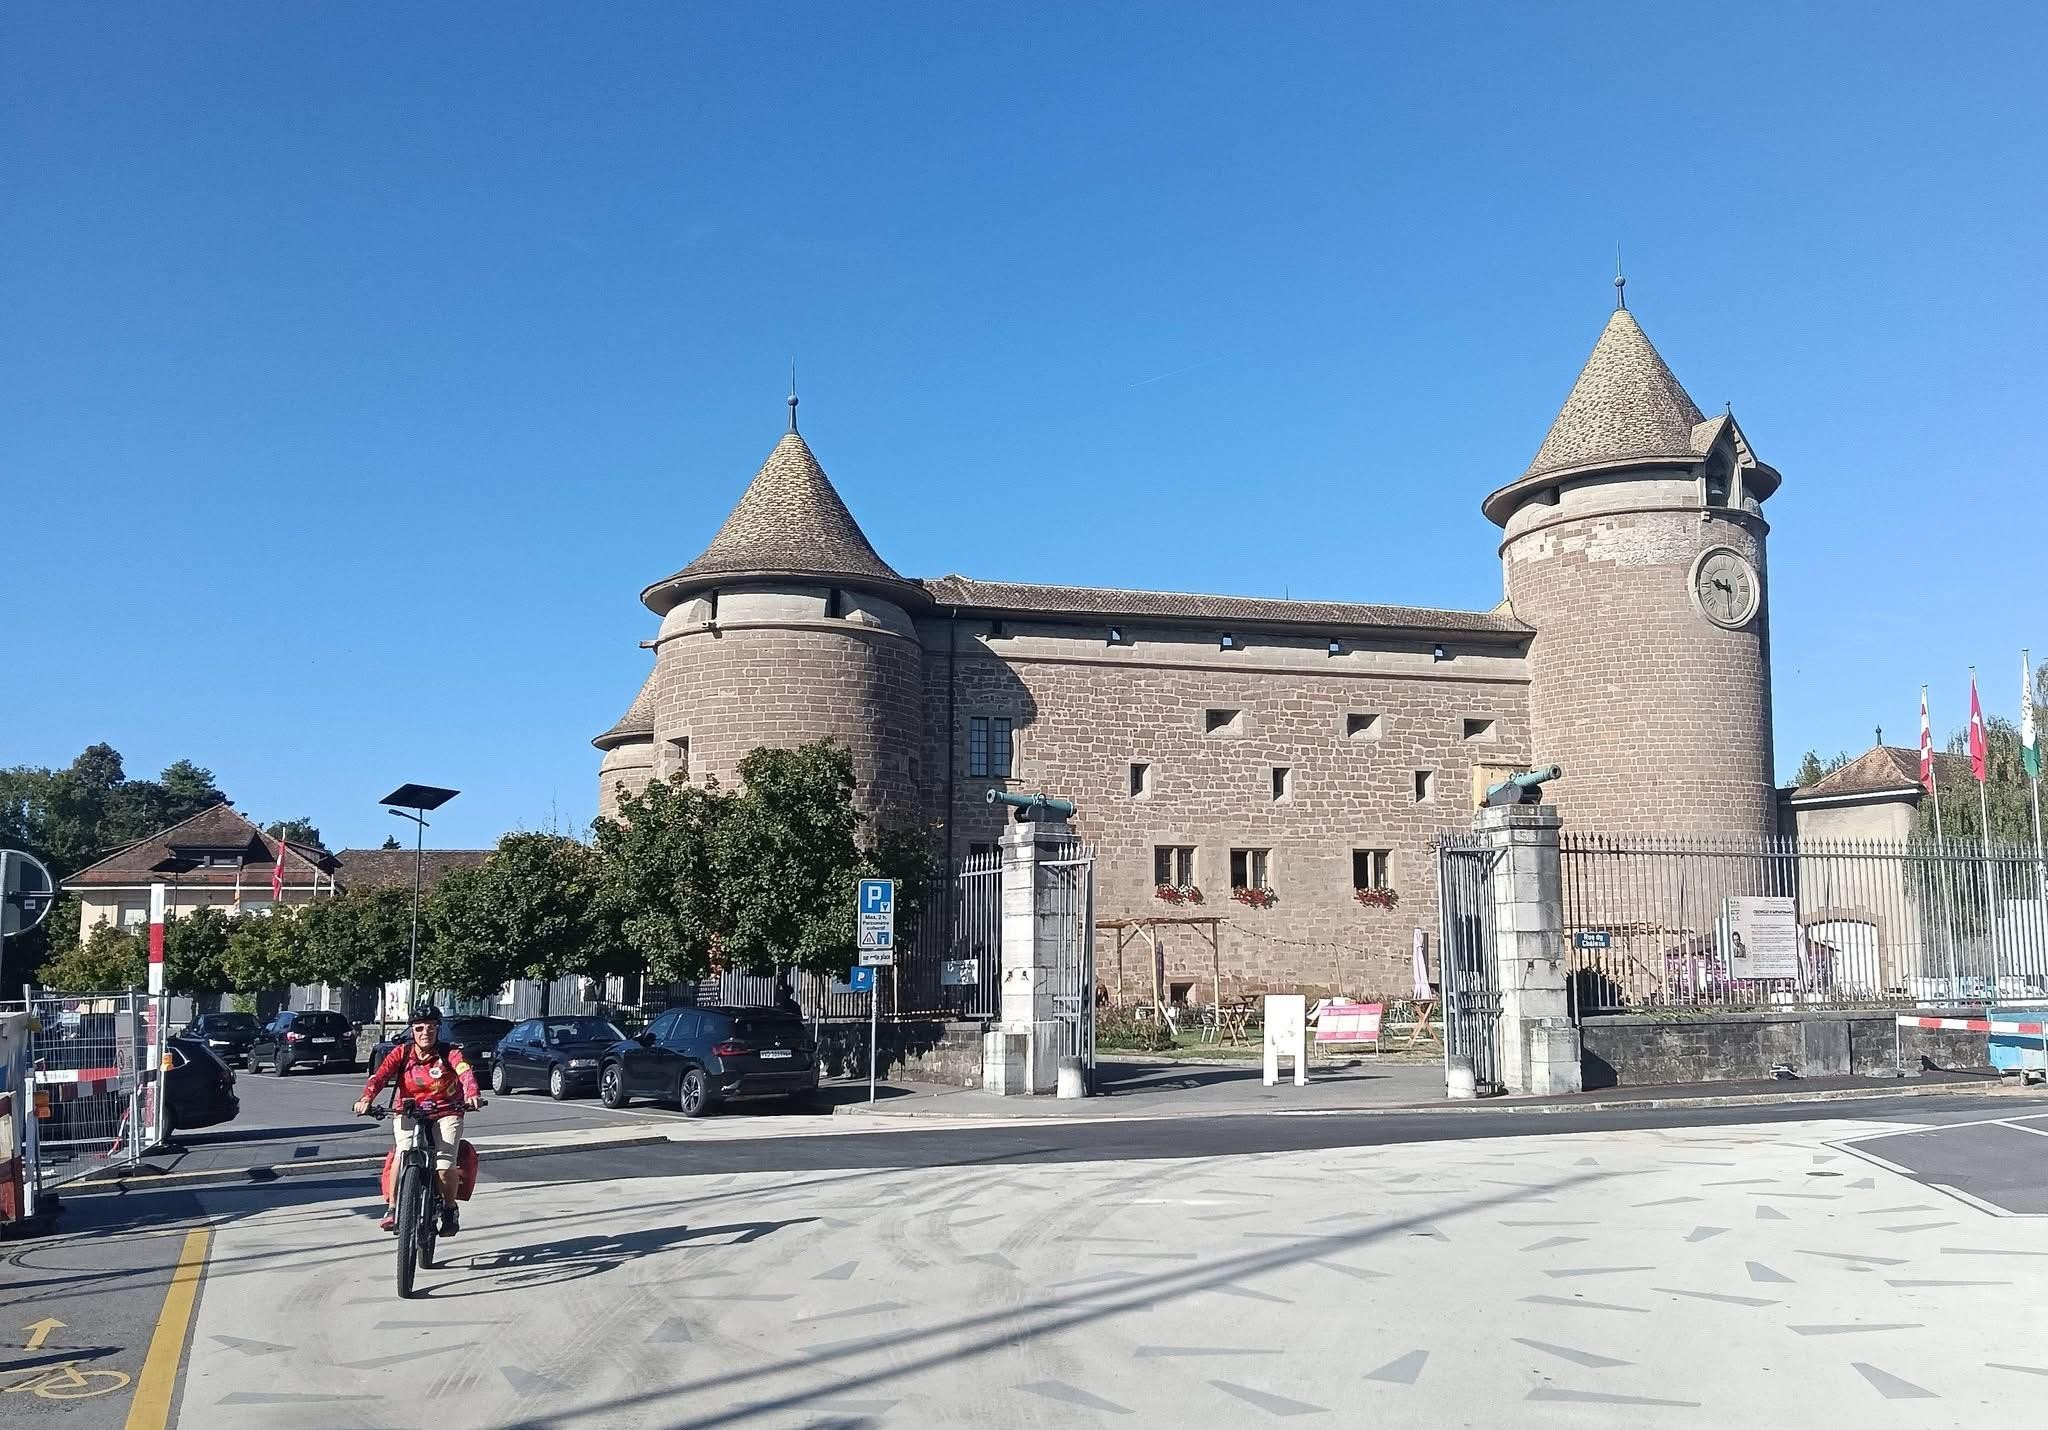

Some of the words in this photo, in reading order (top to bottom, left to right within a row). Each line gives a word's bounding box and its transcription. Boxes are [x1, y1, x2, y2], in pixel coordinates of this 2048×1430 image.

[868, 886, 882, 909] P
[1584, 933, 1595, 941] Rue
[858, 971, 865, 981] P
